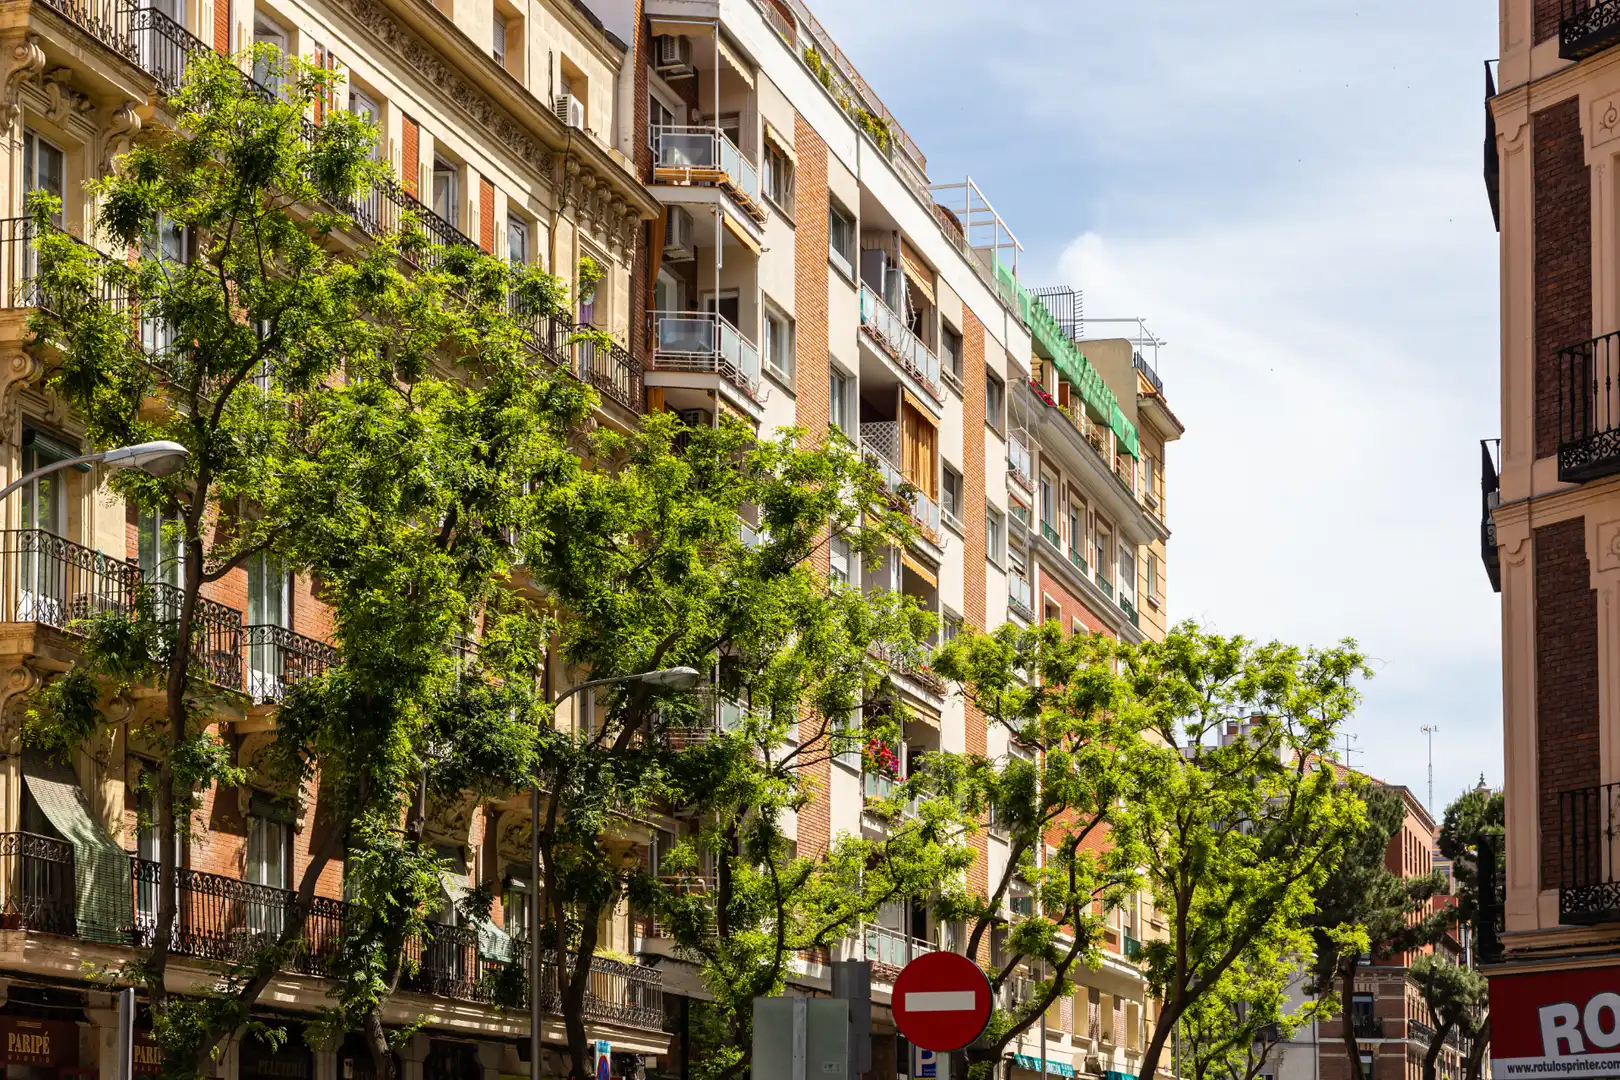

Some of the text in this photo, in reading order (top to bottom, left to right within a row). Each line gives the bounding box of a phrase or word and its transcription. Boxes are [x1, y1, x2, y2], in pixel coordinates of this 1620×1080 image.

[1538, 992, 1620, 1057] RO
[7, 1030, 50, 1055] PARIPÉ
[133, 1044, 163, 1065] PARI
[915, 1045, 937, 1077] P
[1507, 1059, 1620, 1074] www.rotulosprinter.com
